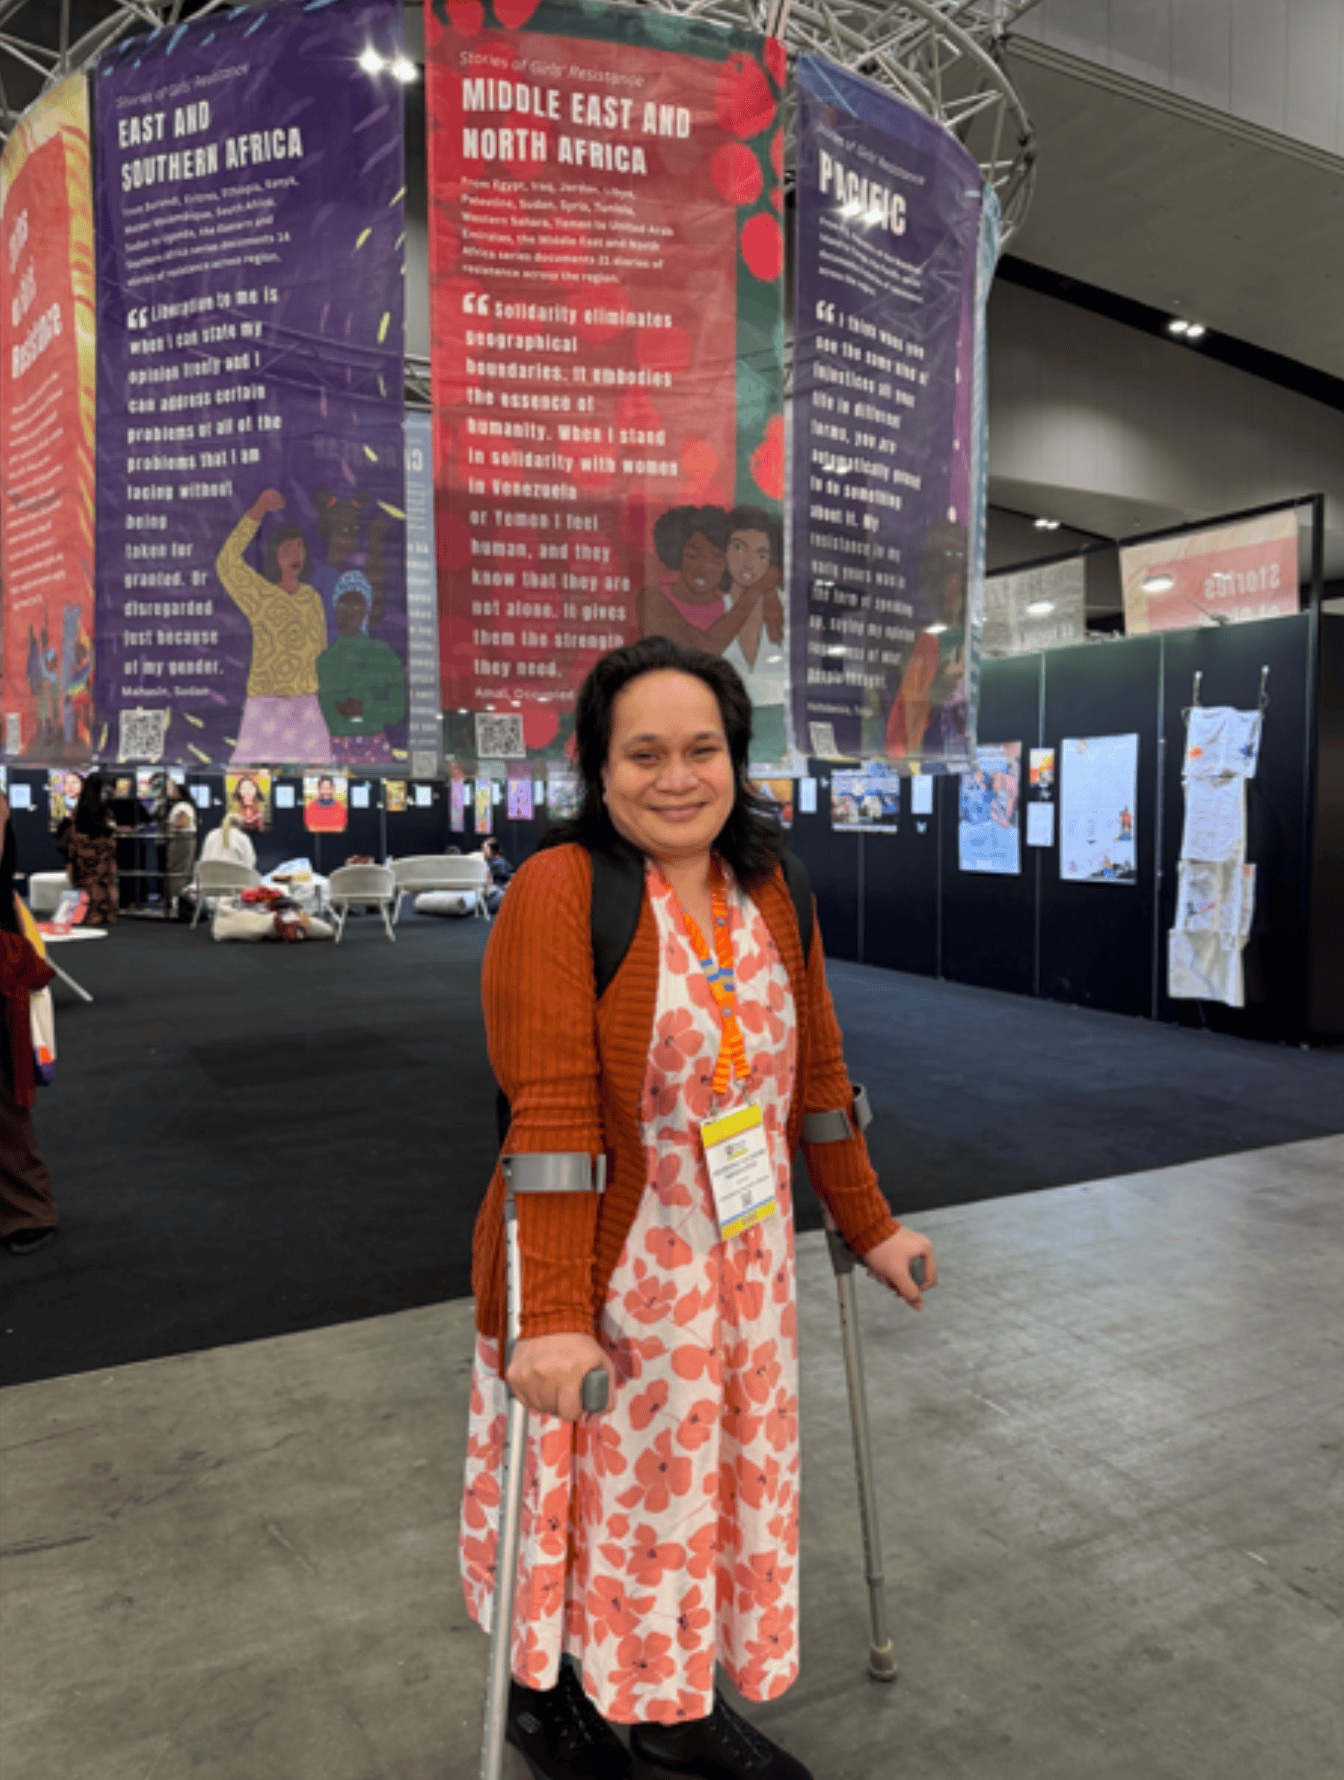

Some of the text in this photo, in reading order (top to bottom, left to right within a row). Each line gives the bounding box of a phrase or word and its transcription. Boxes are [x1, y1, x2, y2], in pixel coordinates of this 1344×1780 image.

[462, 78, 690, 138] MIDDLE EAST AND
[118, 100, 210, 149] EAST AND
[121, 127, 303, 192] SOUTHERN AFRICA
[462, 128, 647, 176] NORTH AFRICA
[819, 149, 906, 236] PACIFIC
[235, 289, 258, 305] me
[264, 285, 278, 304] is
[495, 300, 672, 328] Solidarity eliminates
[130, 321, 262, 355] when I can state my
[465, 329, 577, 353] geographical
[128, 365, 179, 385] opinion
[225, 352, 250, 372] and
[254, 351, 260, 367] I
[593, 366, 672, 388] embodies
[128, 384, 266, 414] can address certain
[466, 386, 594, 411] the essence of
[128, 424, 194, 444] problems
[258, 414, 282, 432] the
[558, 424, 601, 444] When
[608, 426, 613, 444] I
[620, 428, 666, 446] stand
[128, 448, 260, 474] problems that I am
[492, 450, 574, 473] solidarity
[580, 455, 616, 474] with
[623, 459, 678, 476] women
[127, 480, 232, 501] facing without
[126, 514, 167, 530] being
[470, 510, 598, 531] or Yemen I feel
[125, 542, 194, 560] taken for
[540, 544, 568, 560] and
[575, 544, 610, 563] they
[472, 568, 630, 592] know that they are
[124, 600, 212, 618] disregarded
[472, 600, 499, 616] not
[582, 604, 626, 622] gives
[124, 629, 218, 648] just because
[474, 629, 514, 646] them
[522, 631, 547, 648] the
[124, 660, 138, 675] of
[142, 661, 164, 678] my
[474, 659, 512, 678] they
